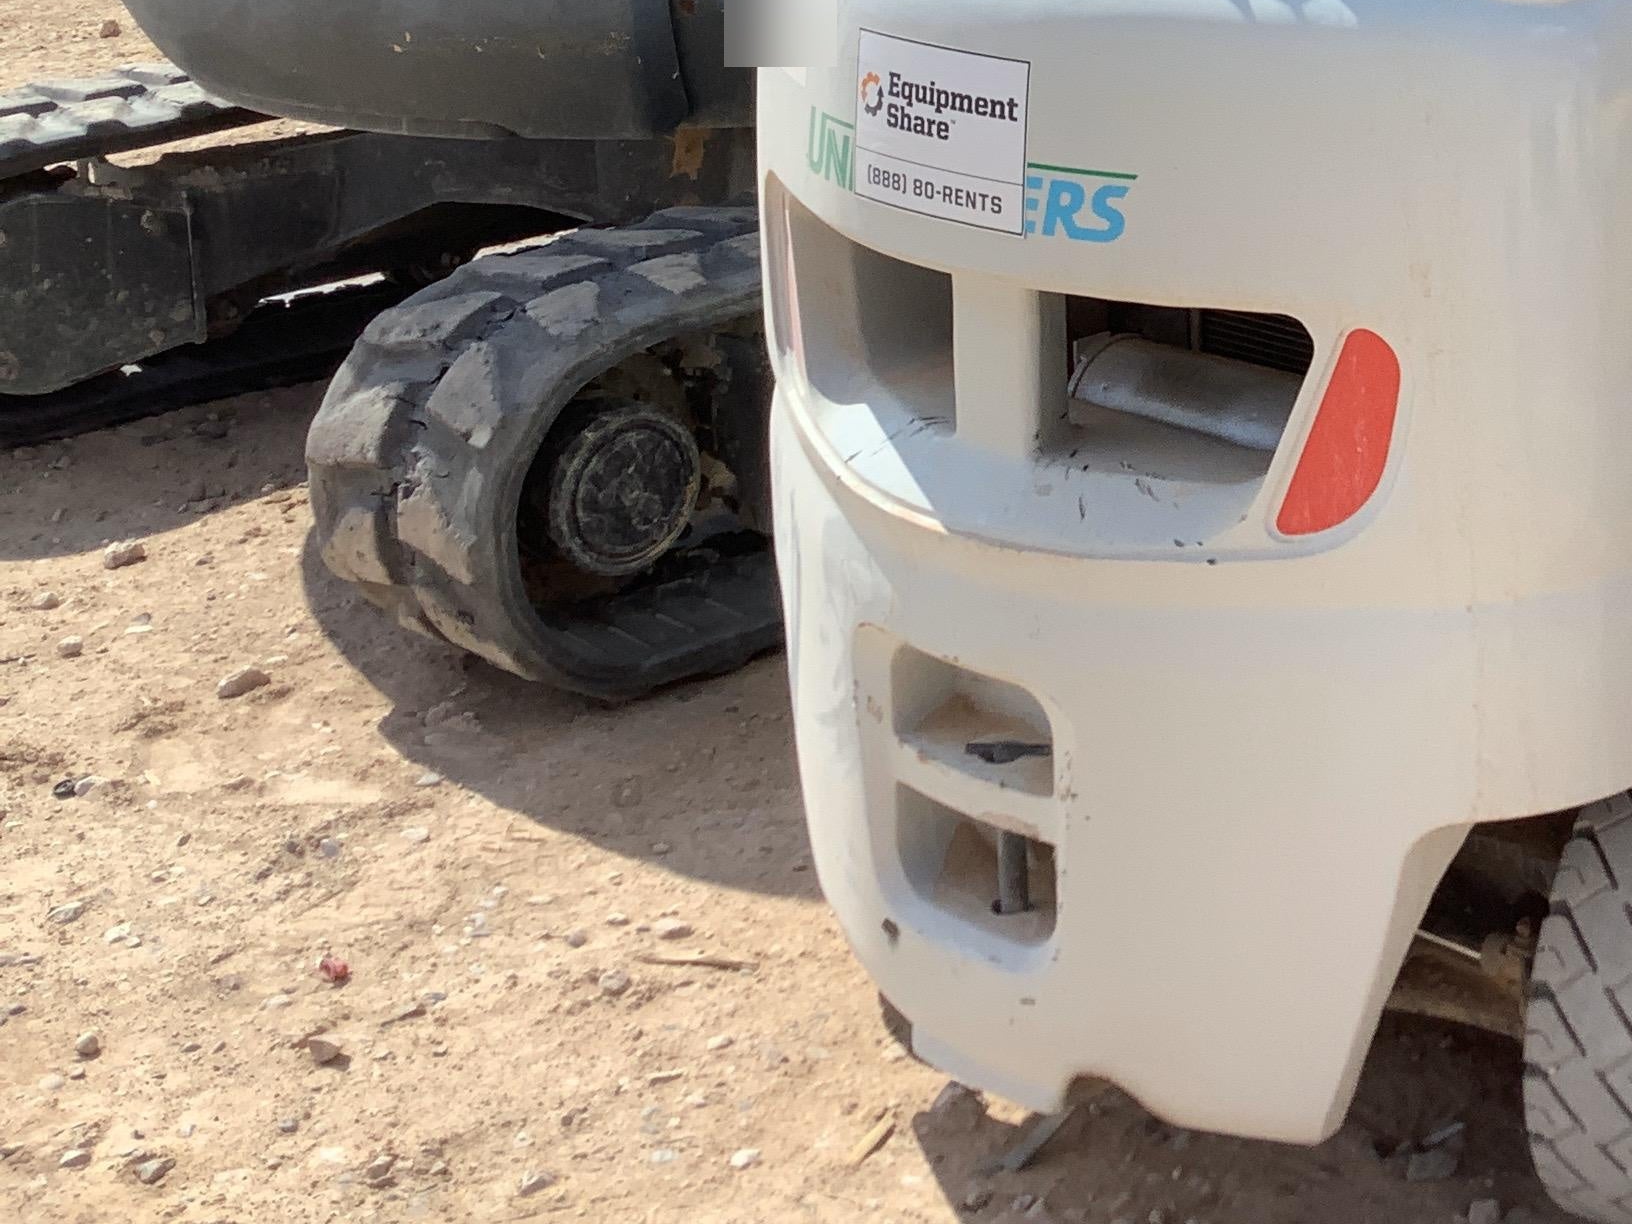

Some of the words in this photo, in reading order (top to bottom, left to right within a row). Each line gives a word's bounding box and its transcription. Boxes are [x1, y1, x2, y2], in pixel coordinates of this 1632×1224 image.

[887, 71, 1019, 122] Equipment
[867, 164, 907, 194] (888)
[912, 178, 1003, 215] 80-RENTS
